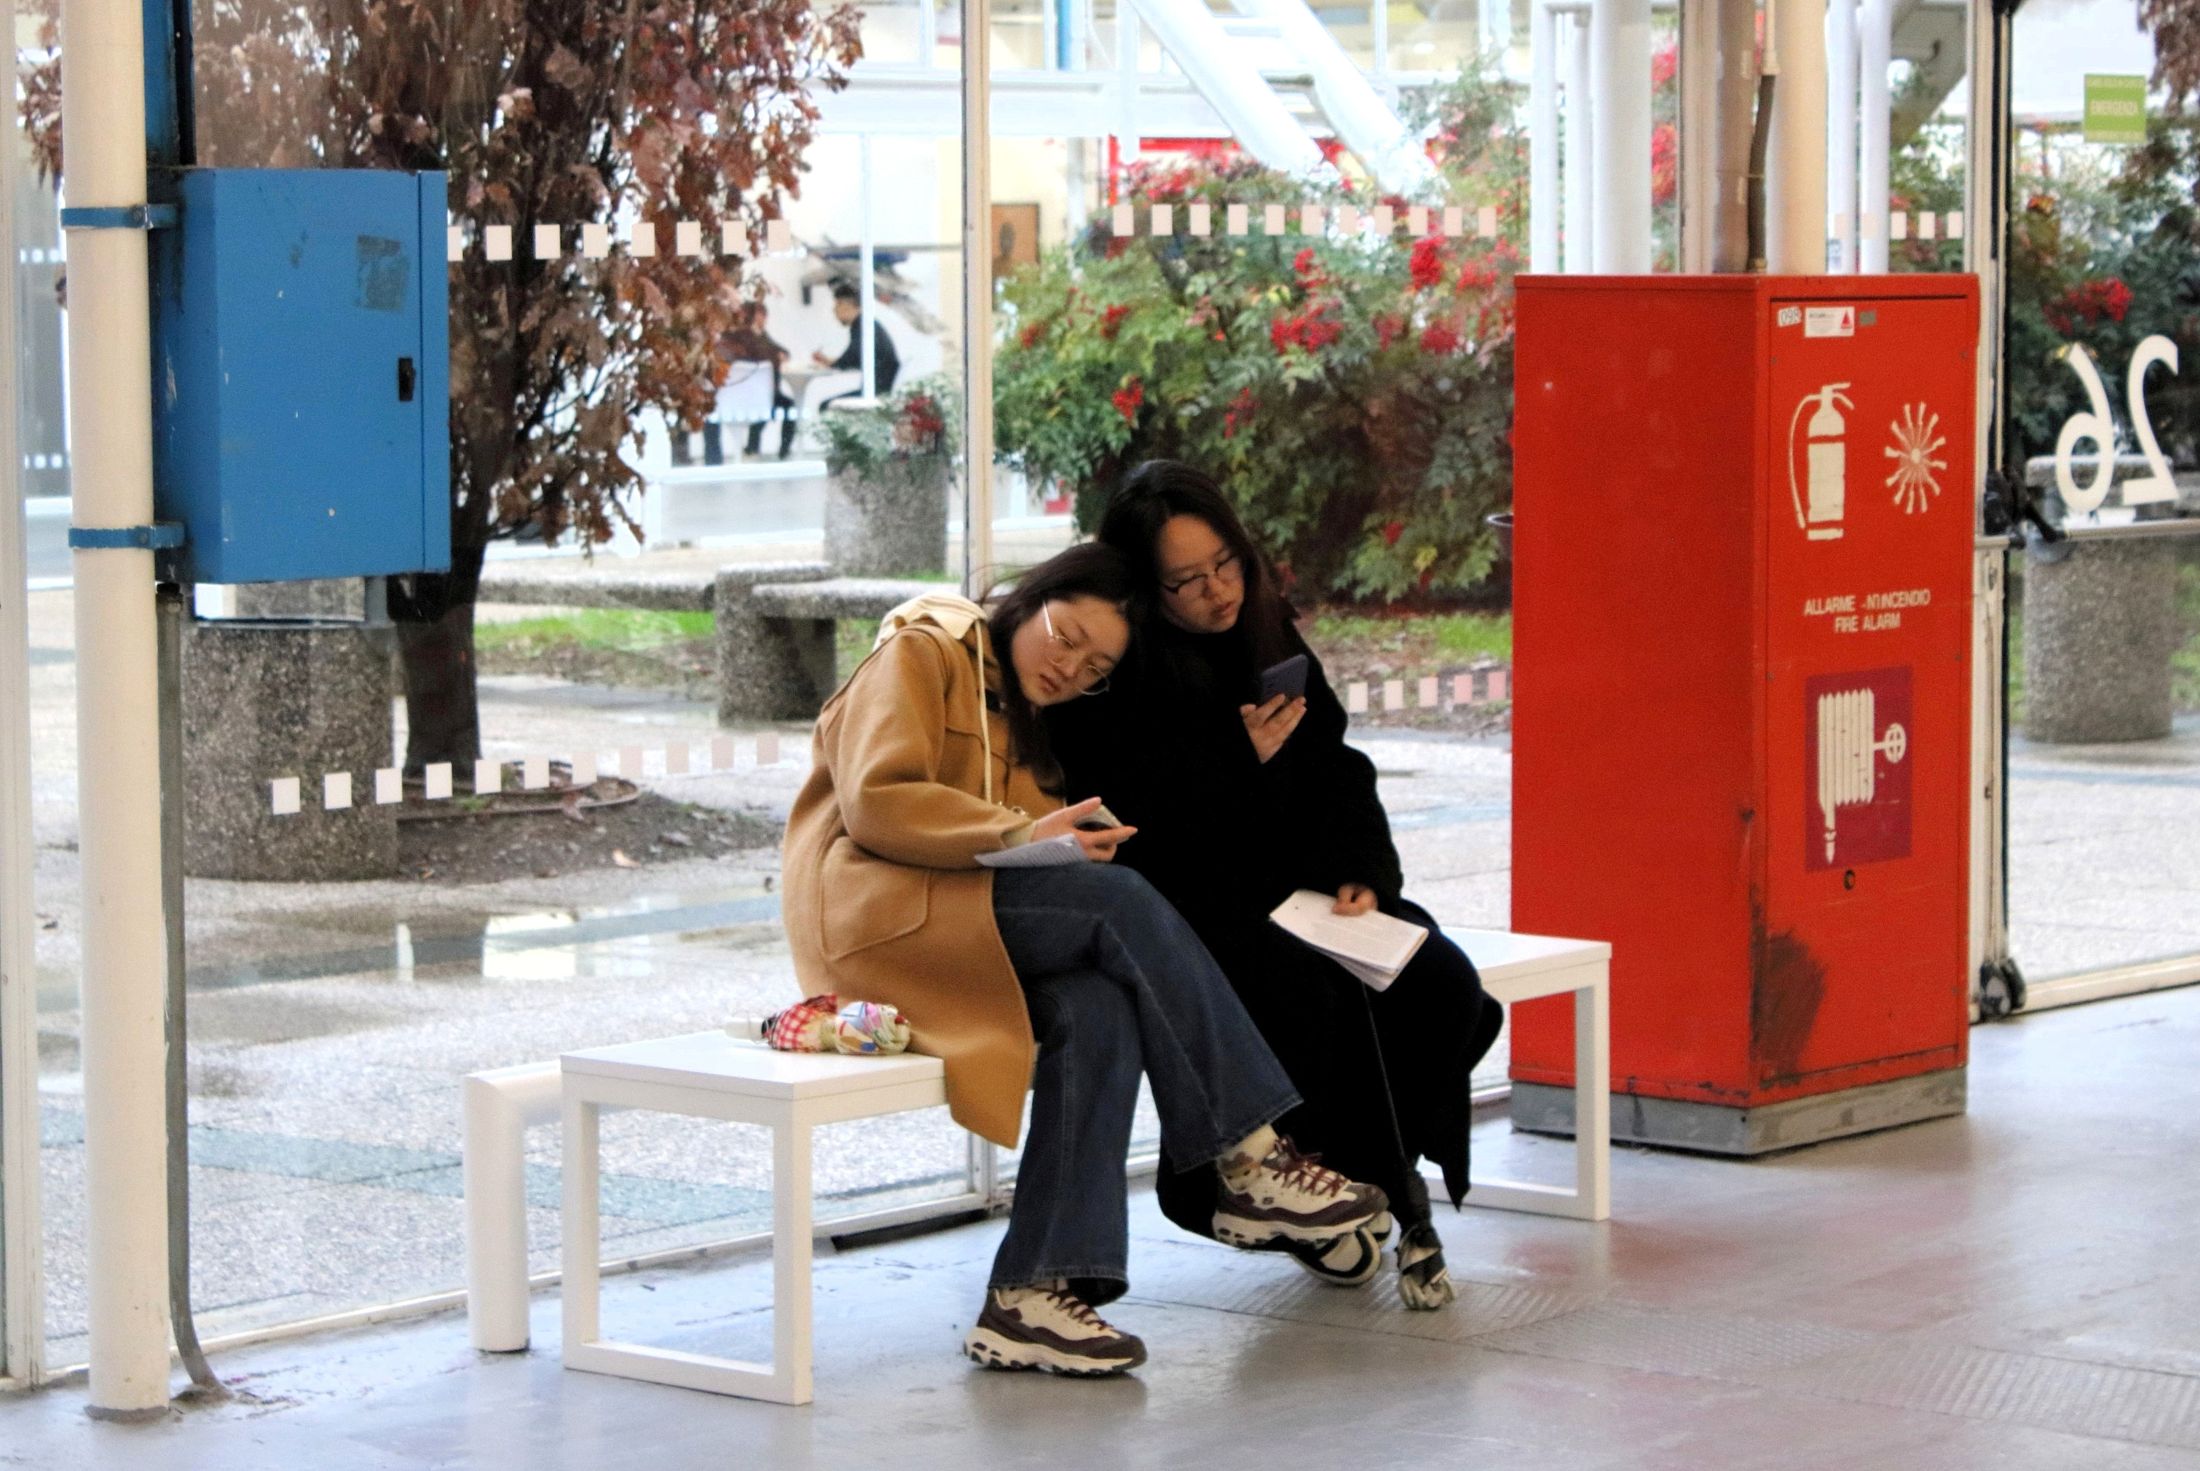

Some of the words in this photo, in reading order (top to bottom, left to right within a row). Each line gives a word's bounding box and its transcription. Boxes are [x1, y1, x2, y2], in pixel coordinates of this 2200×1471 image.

[1804, 595, 1856, 615] ALLARME
[1861, 588, 1931, 609] NTINCENDIO
[1835, 615, 1858, 633] FIRE
[1863, 612, 1901, 631] ALARM
